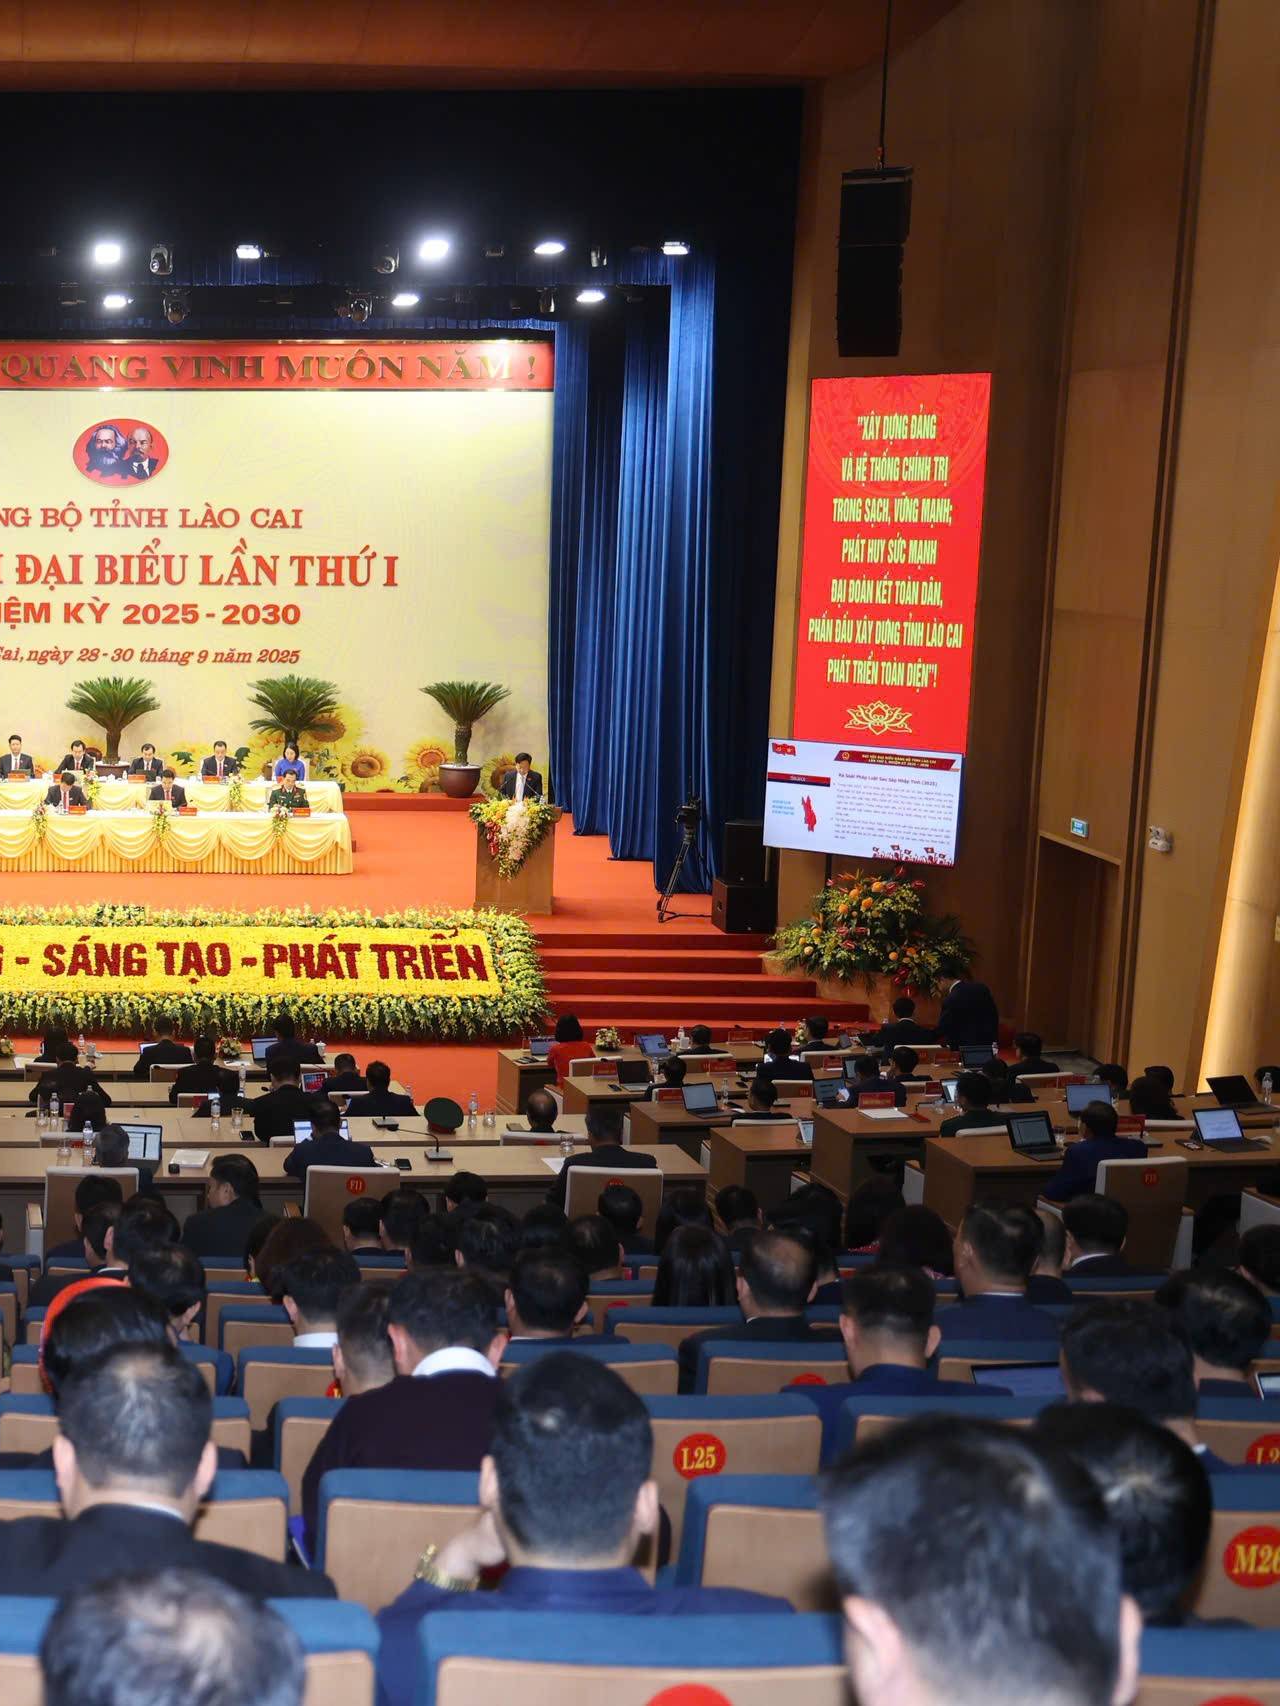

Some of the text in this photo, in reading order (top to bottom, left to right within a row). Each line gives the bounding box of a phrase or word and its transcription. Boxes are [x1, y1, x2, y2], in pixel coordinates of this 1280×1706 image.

[1, 355, 149, 383] QUANG
[161, 356, 265, 380] VINH
[277, 349, 404, 381] MUÔN
[417, 350, 513, 380] NĂM
[883, 411, 908, 444] DỰNG
[910, 405, 936, 439] ĐẢNG
[842, 448, 948, 486] VÀ HỆ THỐNG CHÍNH TRỊ
[40, 501, 82, 531] BỘ
[90, 499, 168, 528] TỈNH
[180, 506, 240, 528] LÀO
[251, 508, 303, 528] CAI
[833, 498, 862, 522] TRONG
[894, 492, 918, 522] VỮNG
[16, 554, 82, 591] ĐẠI
[96, 538, 188, 585] BIỂU
[201, 537, 279, 586] LẦN
[289, 545, 377, 587] THỨ
[383, 556, 399, 587] I
[842, 533, 937, 569] PHÁT HUY SỨC MẠNH
[831, 579, 846, 607] ĐẠI
[849, 575, 873, 603] ĐOÀN
[875, 575, 893, 604] KẾT
[895, 576, 919, 604] TOÀN
[64, 596, 110, 624] KỲ
[123, 604, 199, 624] 2025
[223, 604, 301, 624] 2030
[809, 611, 962, 649] PHẤN ĐẤU XÂY DỰNG TỈNH LÀO CAI
[26, 646, 73, 665] ngày
[140, 648, 193, 665] tháng
[197, 650, 208, 662] 9
[214, 650, 252, 663] năm
[258, 649, 300, 663] 2025
[828, 654, 851, 682] PHÁT
[853, 652, 879, 684] TRIỂN
[881, 657, 904, 686] TOÀN
[43, 936, 147, 976] SÁNG
[157, 942, 231, 984] TẠO
[264, 935, 361, 979] PHÁT
[370, 927, 488, 981] TRIỂN
[681, 1446, 716, 1471] L25
